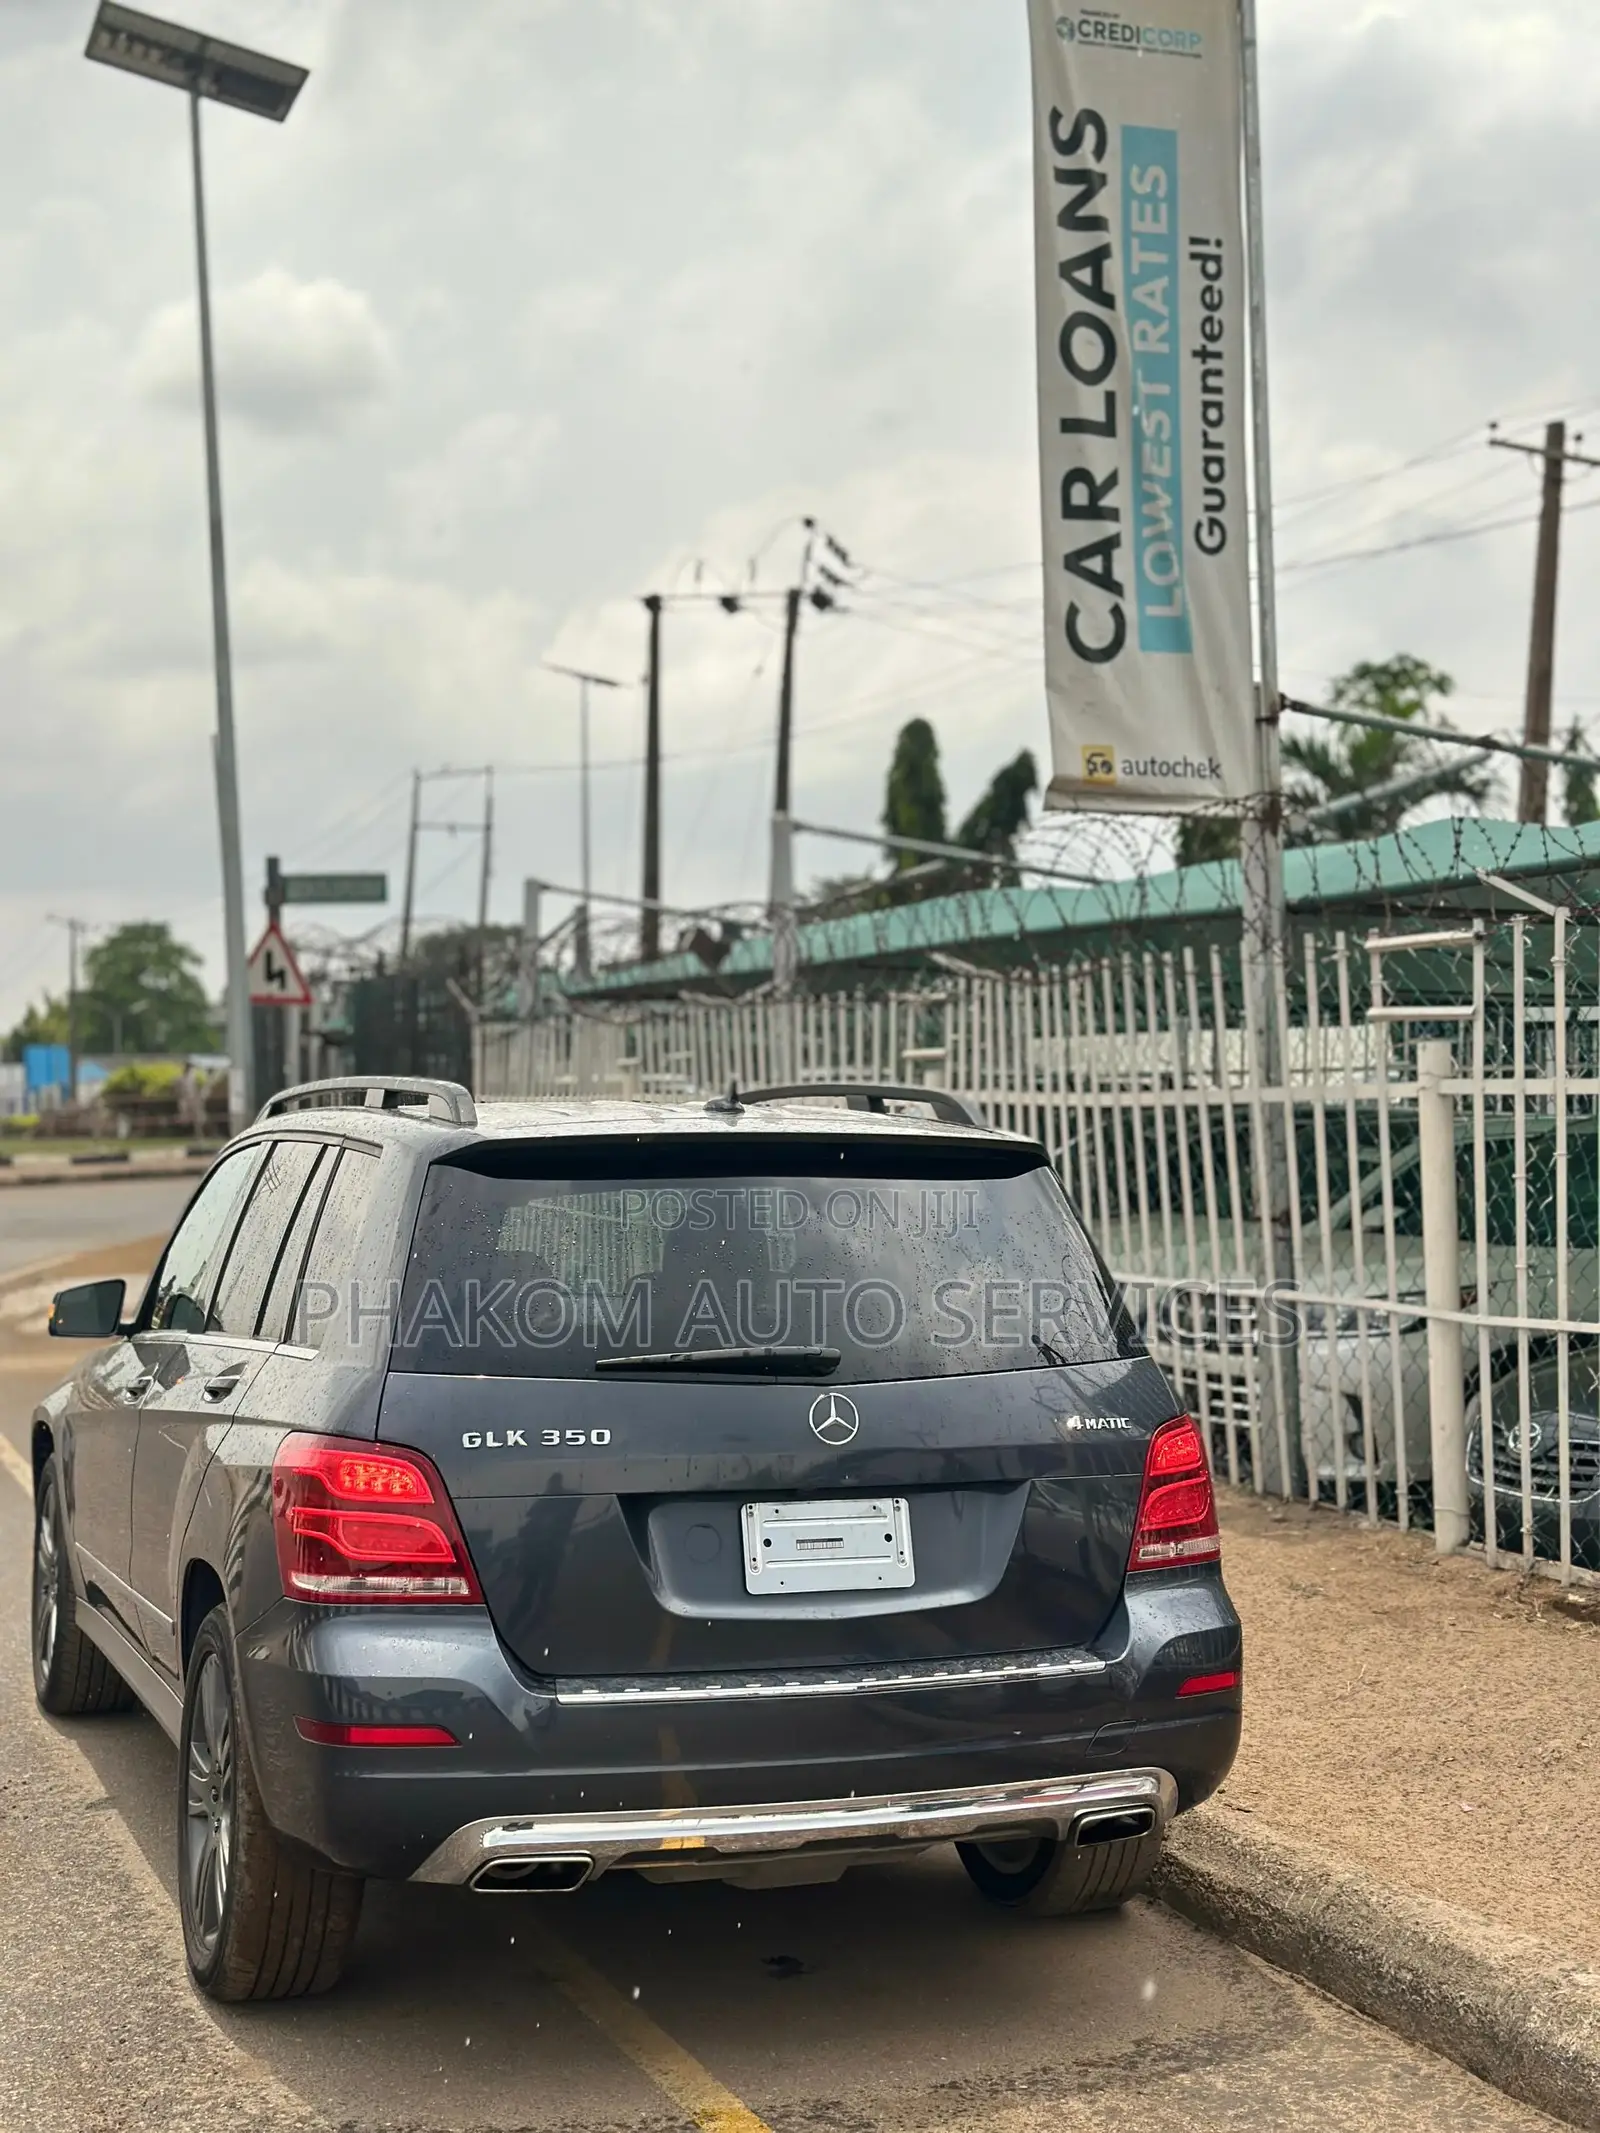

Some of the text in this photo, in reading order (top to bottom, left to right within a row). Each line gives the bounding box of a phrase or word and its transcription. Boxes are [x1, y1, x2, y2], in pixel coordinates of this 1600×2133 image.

[1077, 18, 1203, 51] CREDICORP
[1049, 105, 1126, 664] CAR LOANS
[1130, 164, 1182, 617] LOWEST RATES
[1189, 236, 1227, 556] Guaranteed!
[1121, 755, 1222, 780] autochek
[462, 1428, 612, 1449] GLK 350
